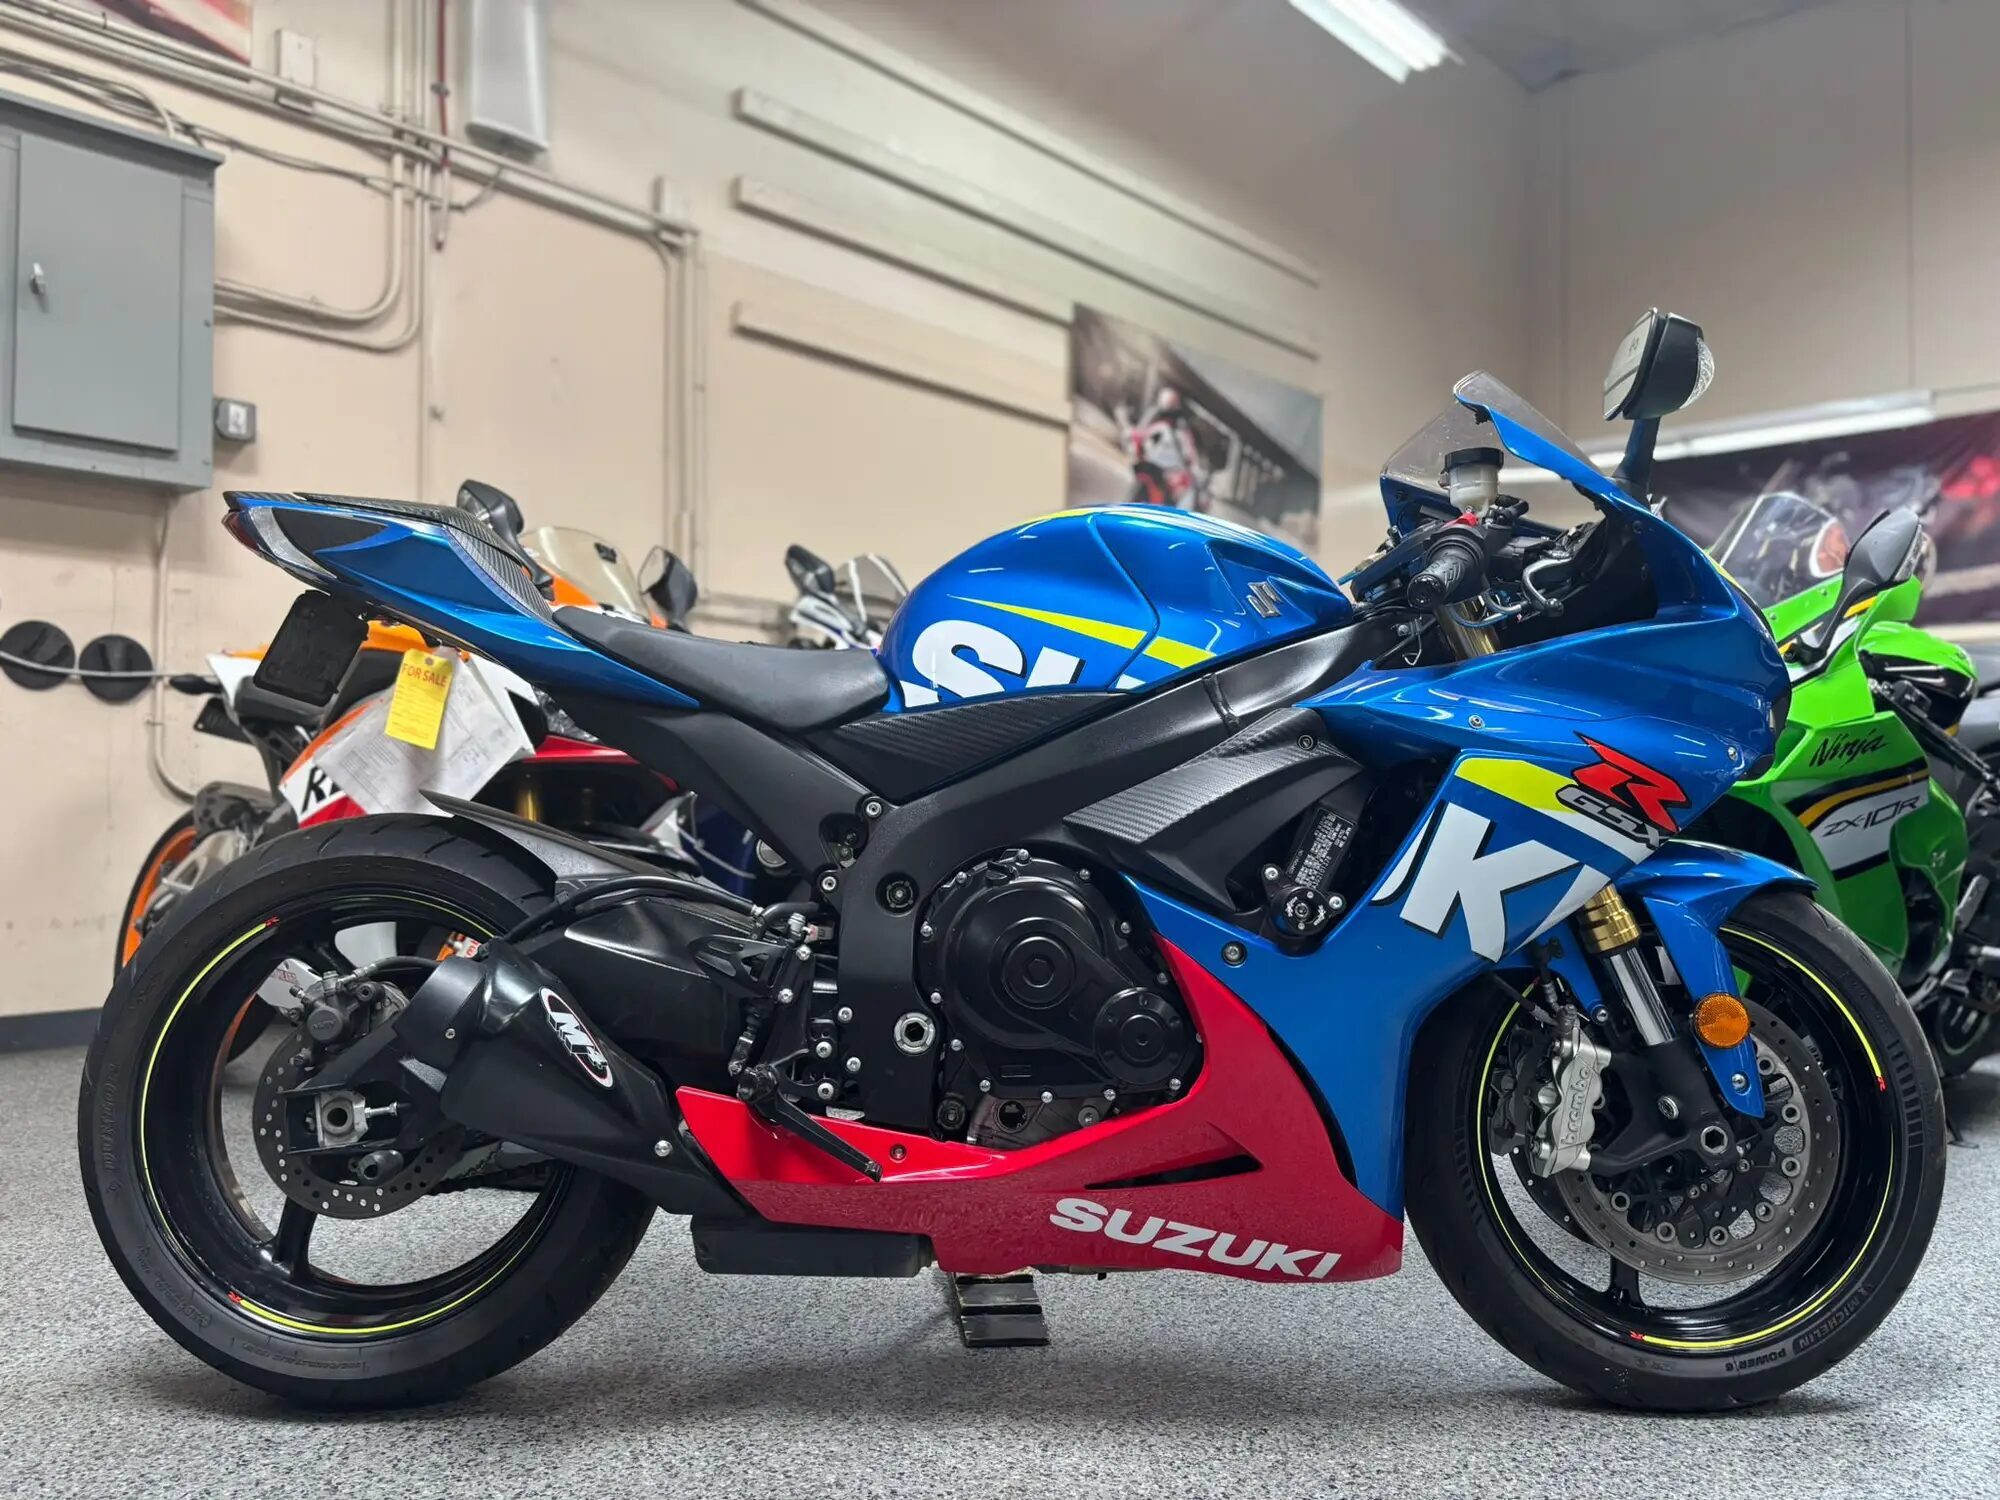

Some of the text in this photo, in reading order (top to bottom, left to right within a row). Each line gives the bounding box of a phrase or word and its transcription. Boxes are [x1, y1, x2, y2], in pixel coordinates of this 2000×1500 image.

[401, 662, 448, 687] FOR SALE
[1809, 728, 1888, 768] Ninja
[1822, 796, 1920, 837] ZX-10R
[1561, 1066, 1592, 1145] brembo
[1050, 1198, 1342, 1279] SUZUKI
[1799, 1296, 1868, 1352] MICHELIN
[1739, 1349, 1787, 1371] POWER
